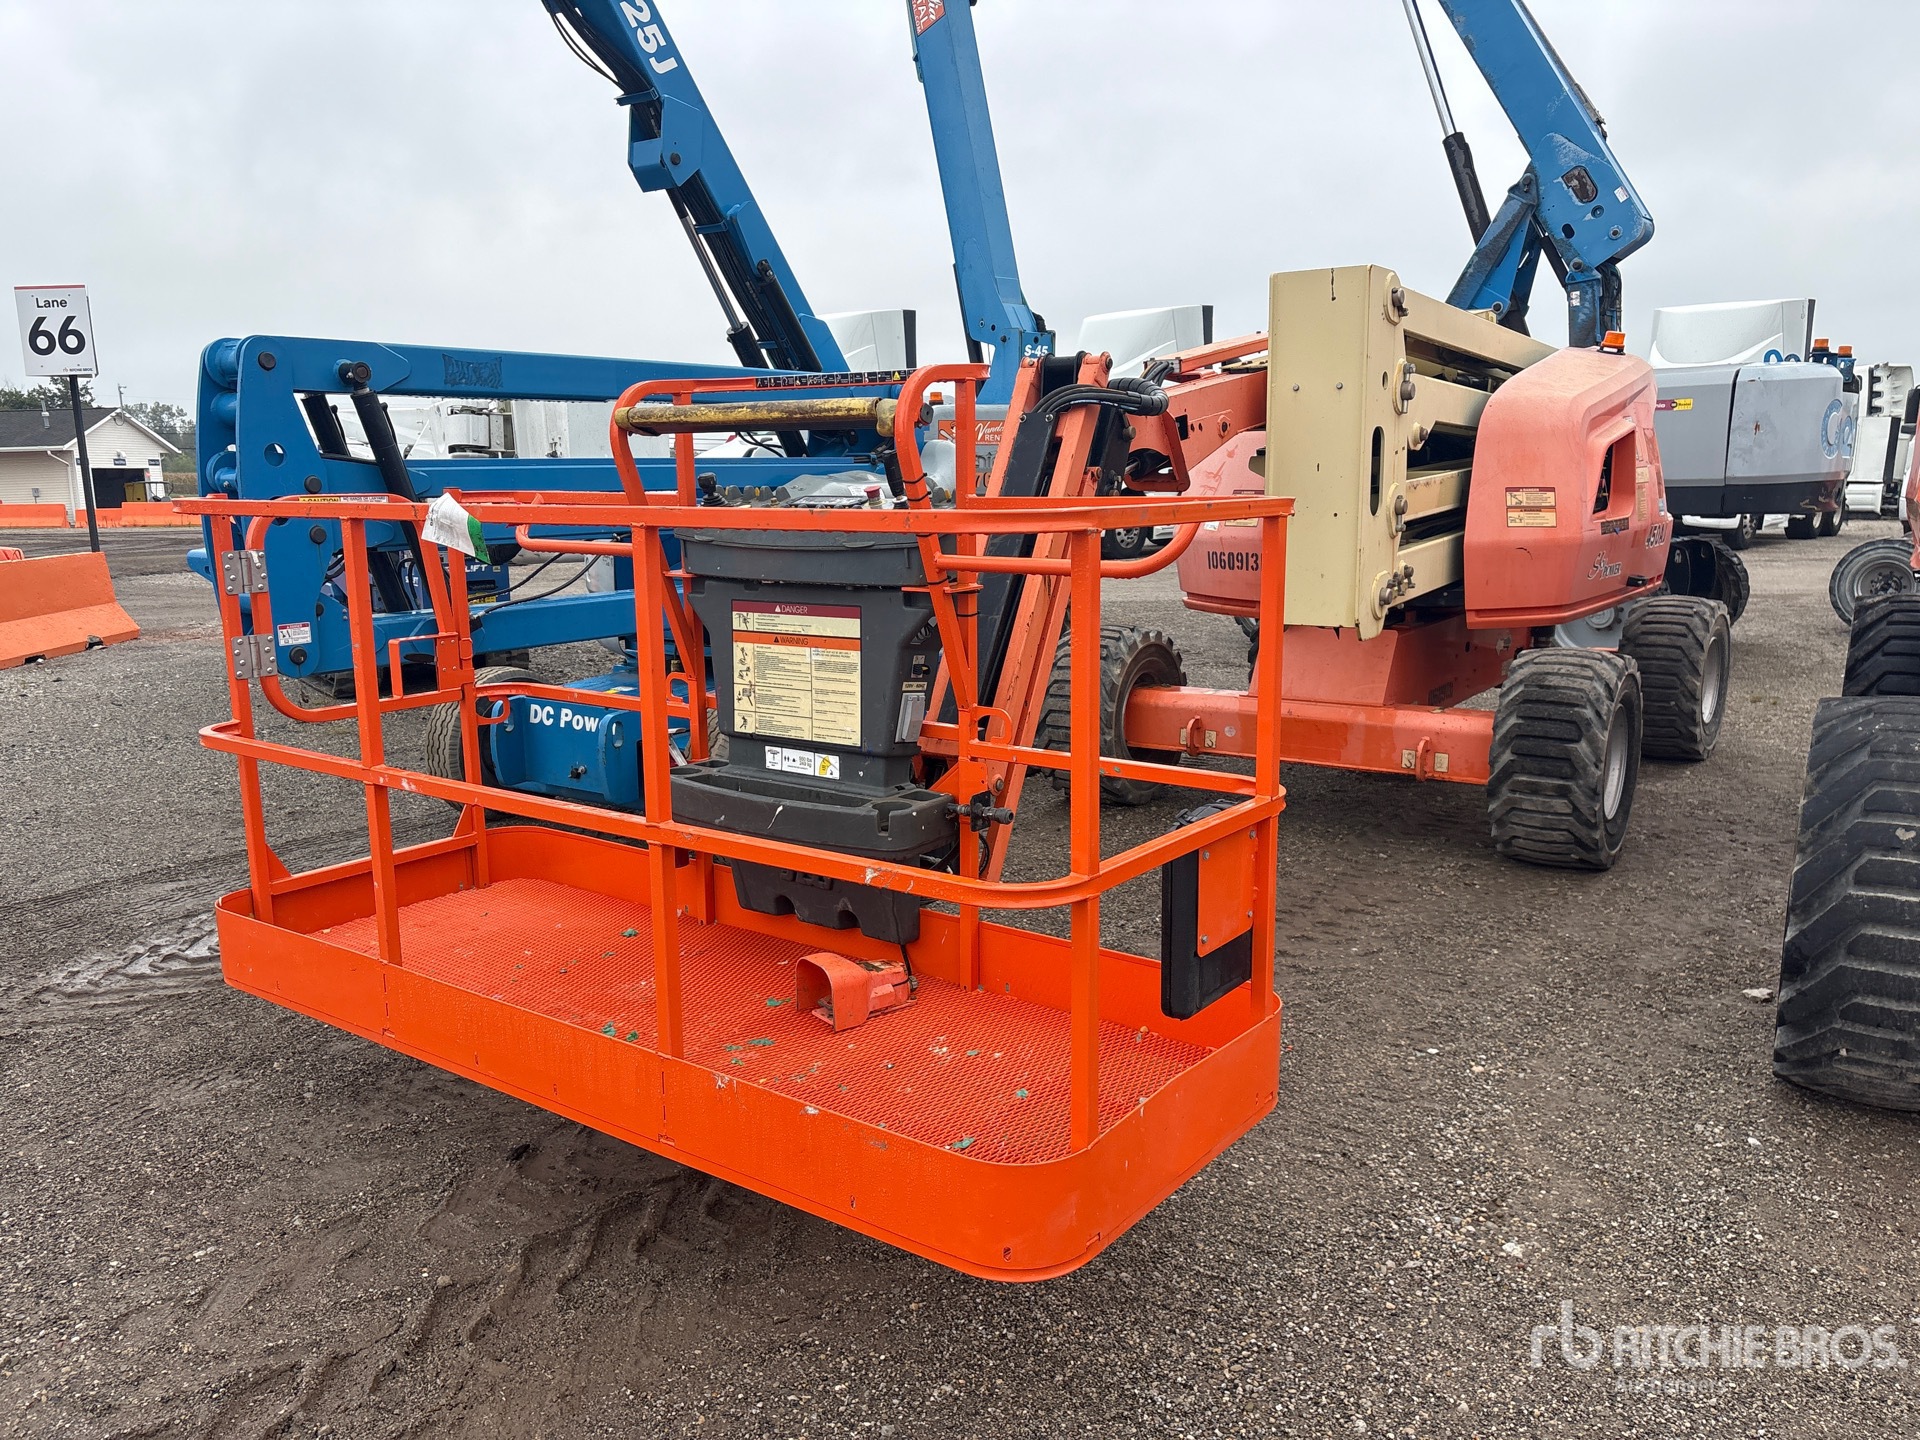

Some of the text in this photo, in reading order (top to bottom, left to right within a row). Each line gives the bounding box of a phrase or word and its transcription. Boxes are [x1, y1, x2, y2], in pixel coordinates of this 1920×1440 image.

[36, 297, 68, 308] Lane
[28, 315, 86, 356] 66
[1024, 344, 1049, 357] S-45
[985, 433, 1002, 442] REN
[1208, 551, 1262, 572] 1060913
[781, 604, 808, 614] DANGER
[779, 636, 809, 646] WARNING
[529, 703, 600, 733] DC Pow
